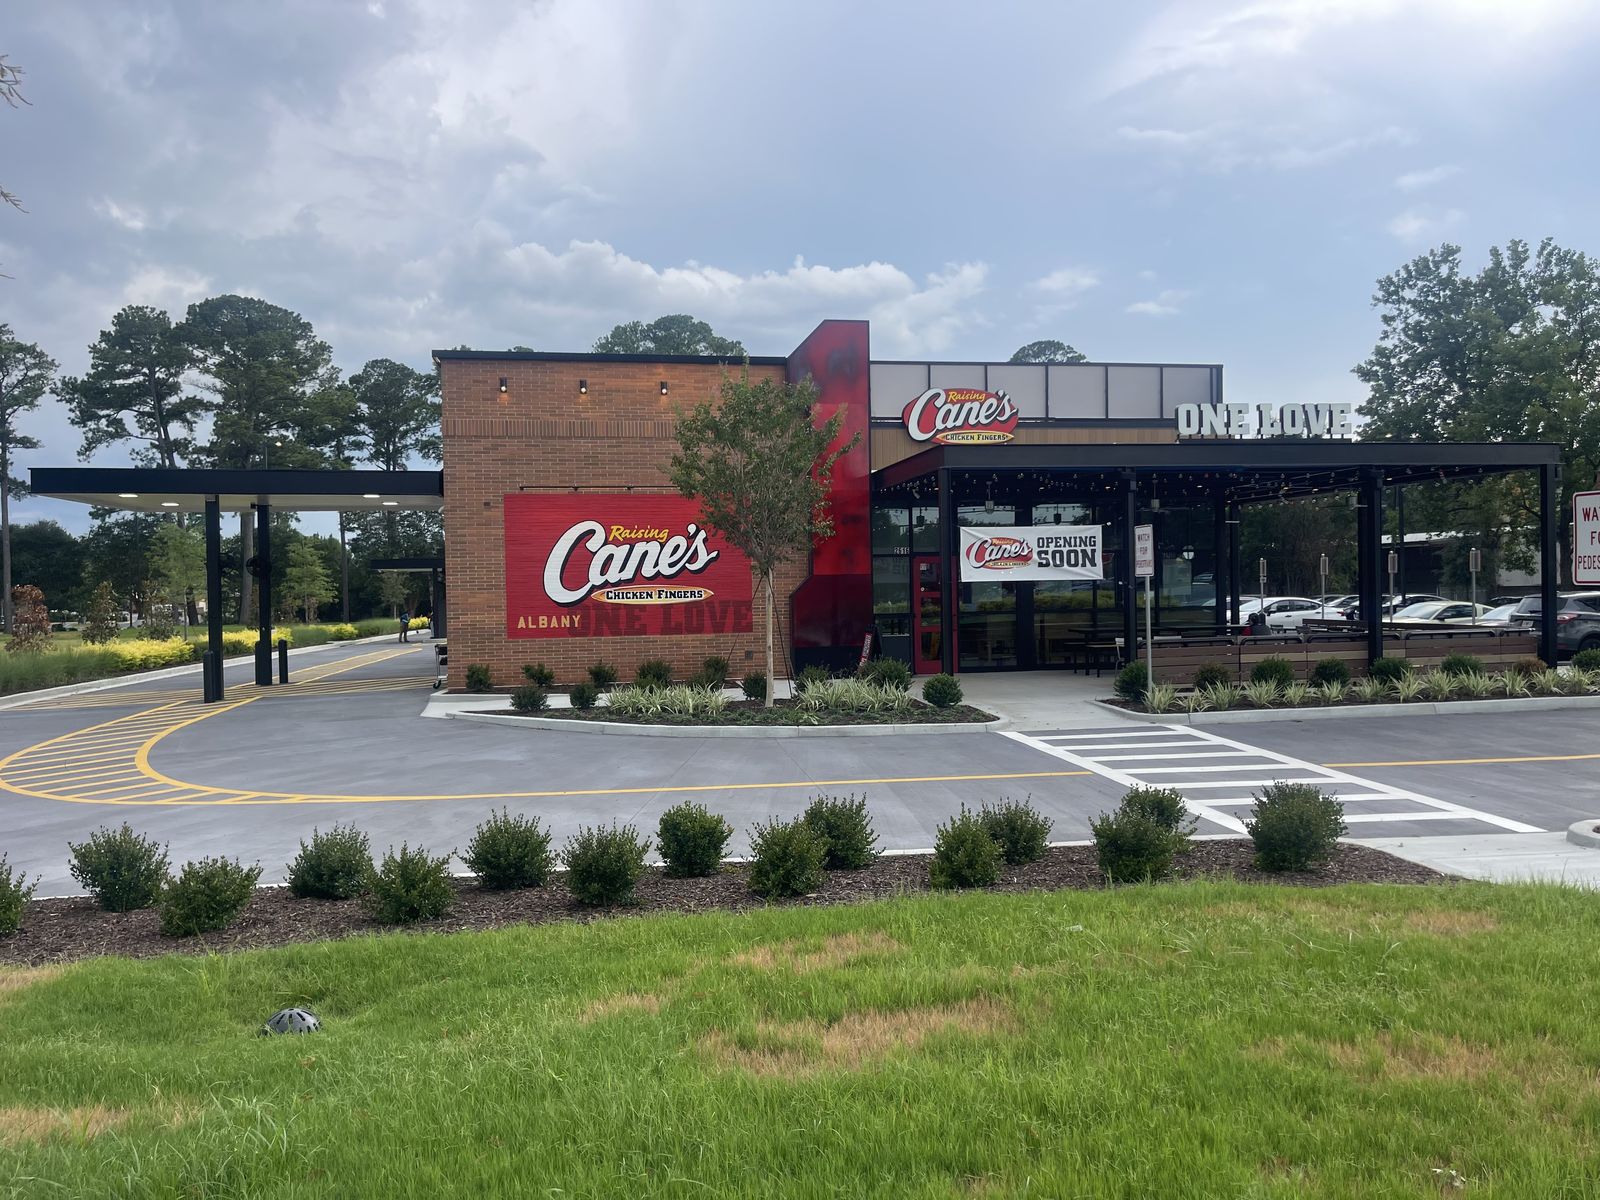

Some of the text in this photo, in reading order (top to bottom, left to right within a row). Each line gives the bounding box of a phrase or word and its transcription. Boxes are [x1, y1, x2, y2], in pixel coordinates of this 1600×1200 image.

[948, 391, 986, 403] Raising
[907, 388, 1018, 441] Cane's
[1177, 403, 1353, 436] ONE LOVE
[1582, 506, 1600, 521] WA
[609, 525, 669, 543] Raising
[1036, 536, 1097, 548] OPENING
[969, 537, 1033, 569] Cane's
[1037, 549, 1097, 568] SOON
[543, 520, 720, 607] Cane's
[606, 589, 703, 600] CHICKEN FINGERS
[517, 614, 581, 629] ALBANY
